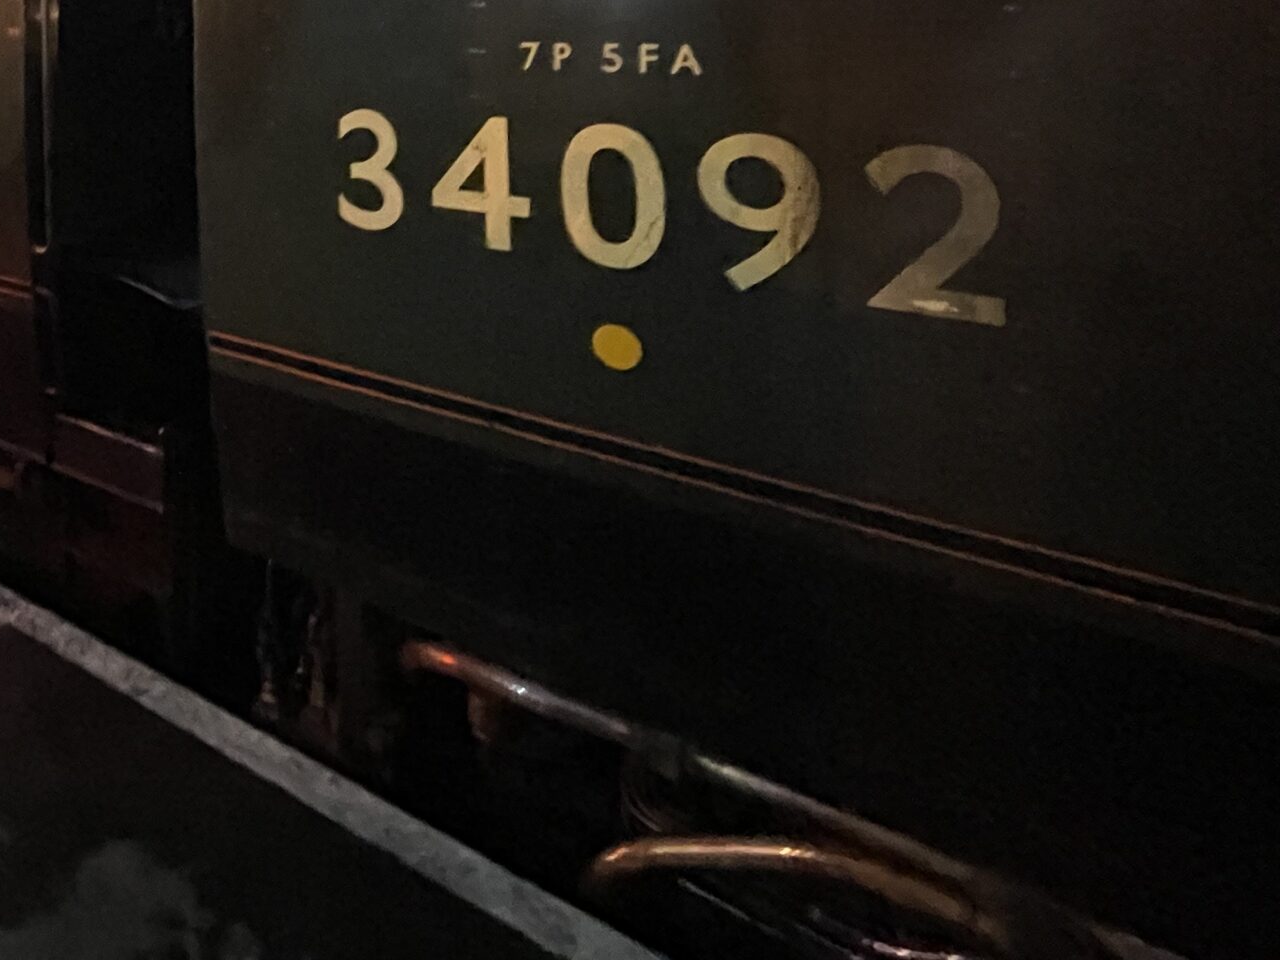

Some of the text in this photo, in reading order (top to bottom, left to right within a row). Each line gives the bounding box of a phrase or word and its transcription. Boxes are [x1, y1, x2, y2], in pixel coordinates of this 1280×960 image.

[519, 41, 703, 76] 7P 5FA
[337, 108, 1006, 327] 34092
